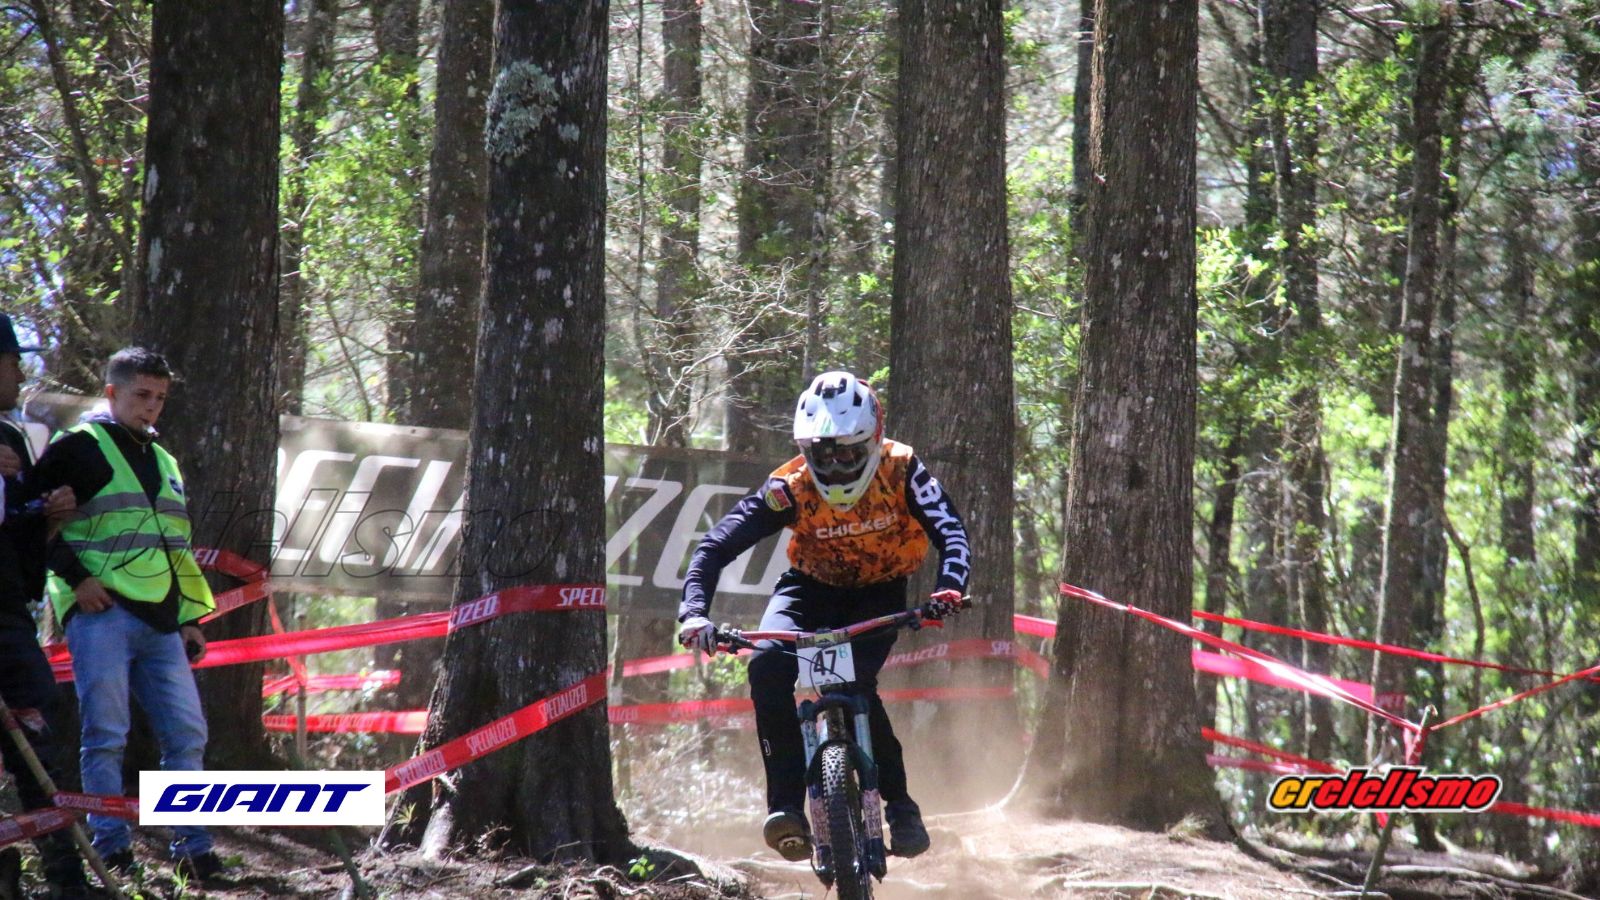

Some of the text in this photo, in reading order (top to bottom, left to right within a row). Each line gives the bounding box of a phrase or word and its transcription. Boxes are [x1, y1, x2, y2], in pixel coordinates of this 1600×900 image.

[813, 649, 837, 676] 47
[538, 683, 588, 724] SPECIALIZED
[466, 717, 518, 757] SPECIALIZED
[394, 750, 447, 787] SPECIALIZED
